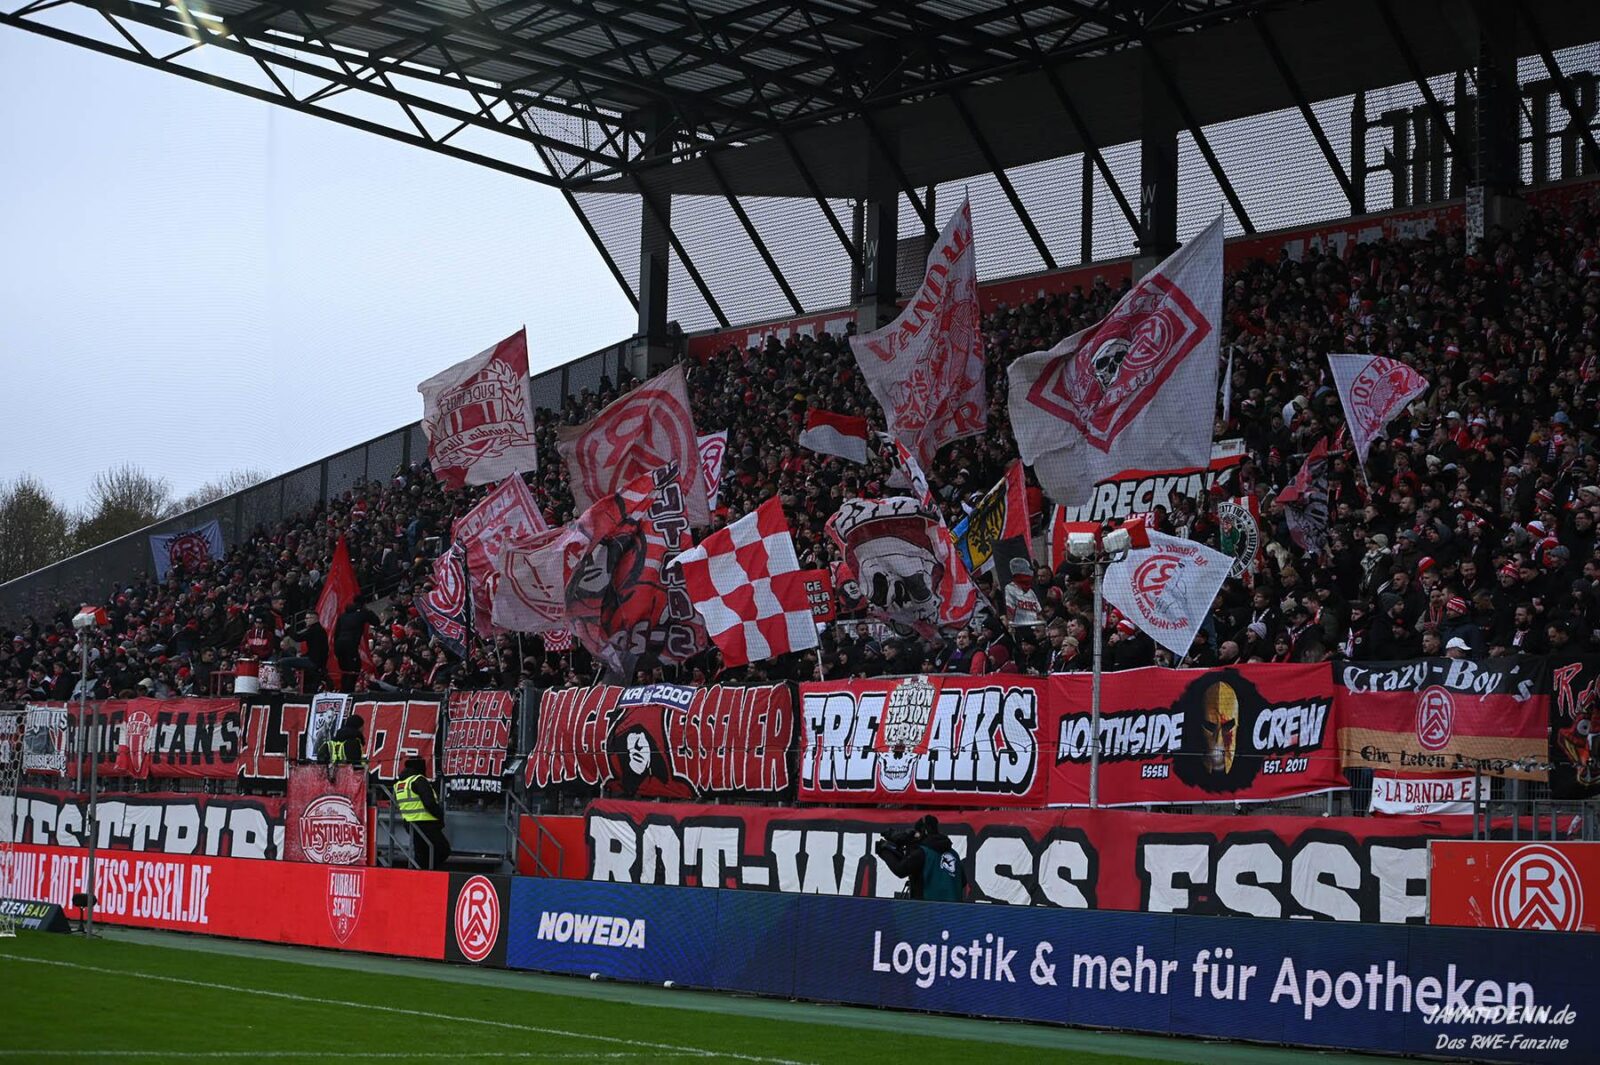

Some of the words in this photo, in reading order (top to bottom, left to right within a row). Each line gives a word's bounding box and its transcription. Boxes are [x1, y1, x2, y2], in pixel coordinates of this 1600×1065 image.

[1141, 184, 1156, 204] W
[1144, 208, 1151, 231] 1
[866, 240, 879, 257] W
[868, 262, 874, 281] 1
[622, 688, 645, 700] KAI
[652, 685, 692, 704] 2000
[153, 711, 240, 765] FANS
[525, 685, 625, 788] JUNGE
[667, 681, 794, 793] ESSENER
[1058, 712, 1185, 759] NORTHSIDE
[1252, 704, 1326, 750] CREW
[1142, 764, 1168, 778] ESSEN
[1263, 759, 1283, 773] EST.
[1285, 758, 1308, 772] 2011
[1401, 750, 1445, 768] Leben
[1385, 782, 1401, 802] LA
[1405, 782, 1454, 803] BANDA
[0, 795, 285, 860] WESTTRIB
[590, 815, 1089, 909] ROT-WESS
[1144, 841, 1427, 924] ESSE
[537, 911, 646, 949] NOWEDA
[873, 931, 1017, 989] Logistik
[1029, 942, 1058, 986] &
[1072, 945, 1178, 994] mehr
[1192, 947, 1257, 1001] für
[1269, 956, 1535, 1020] Apotheken
